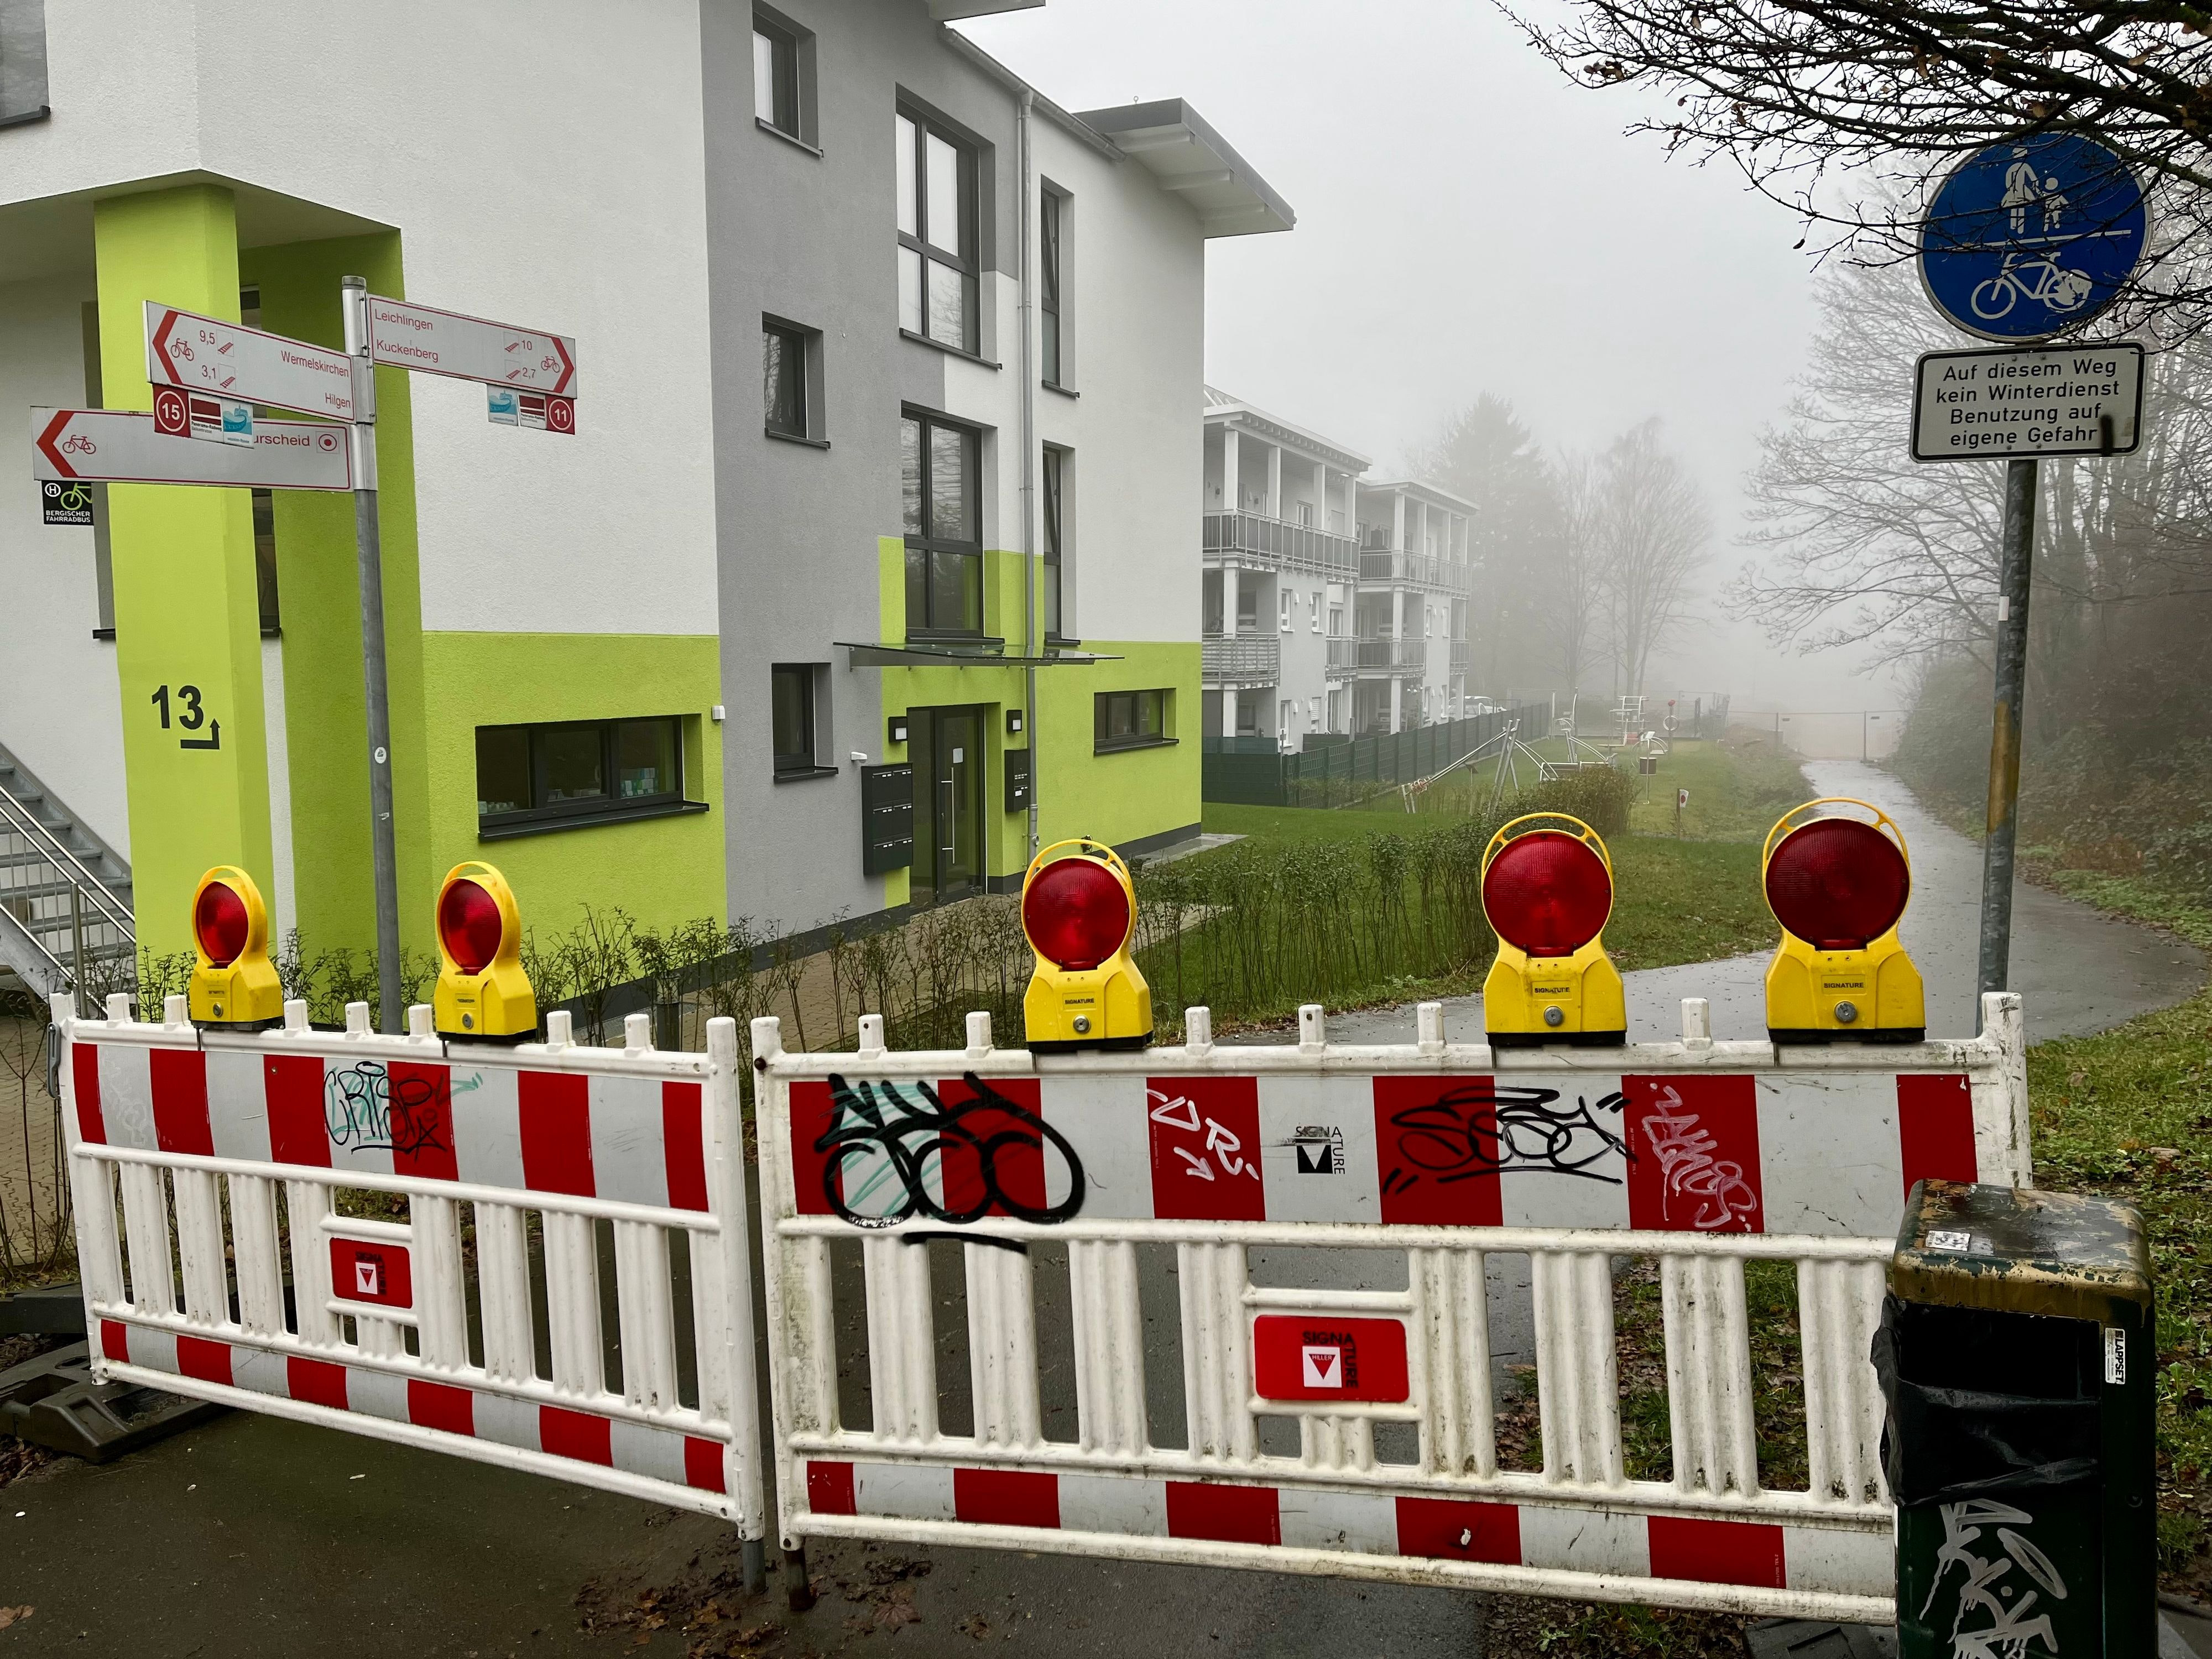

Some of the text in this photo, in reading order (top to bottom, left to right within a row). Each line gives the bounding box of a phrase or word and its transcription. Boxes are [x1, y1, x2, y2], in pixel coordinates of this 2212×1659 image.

[375, 309, 532, 351] Leichlingen 10
[200, 330, 349, 377] 9,5 Wermelskirchen
[377, 339, 536, 379] Kuckenberg 2,7
[1943, 358, 2117, 382] Auf diesem Weg
[202, 365, 351, 409] 3,1 Hilgen
[1937, 380, 2120, 404] kein Winterdienst
[162, 403, 180, 420] 15
[555, 408, 567, 421] 11
[1950, 403, 2101, 424] Benutzung auf
[253, 434, 310, 446] urscheid
[1950, 425, 2097, 449] eigene Gefahr
[152, 685, 204, 730] 13
[1294, 1126, 1342, 1138] SNA
[1302, 1331, 1354, 1345] SIGNA
[1344, 1345, 1359, 1389] TURE
[2115, 1338, 2124, 1383] LAPPSET
